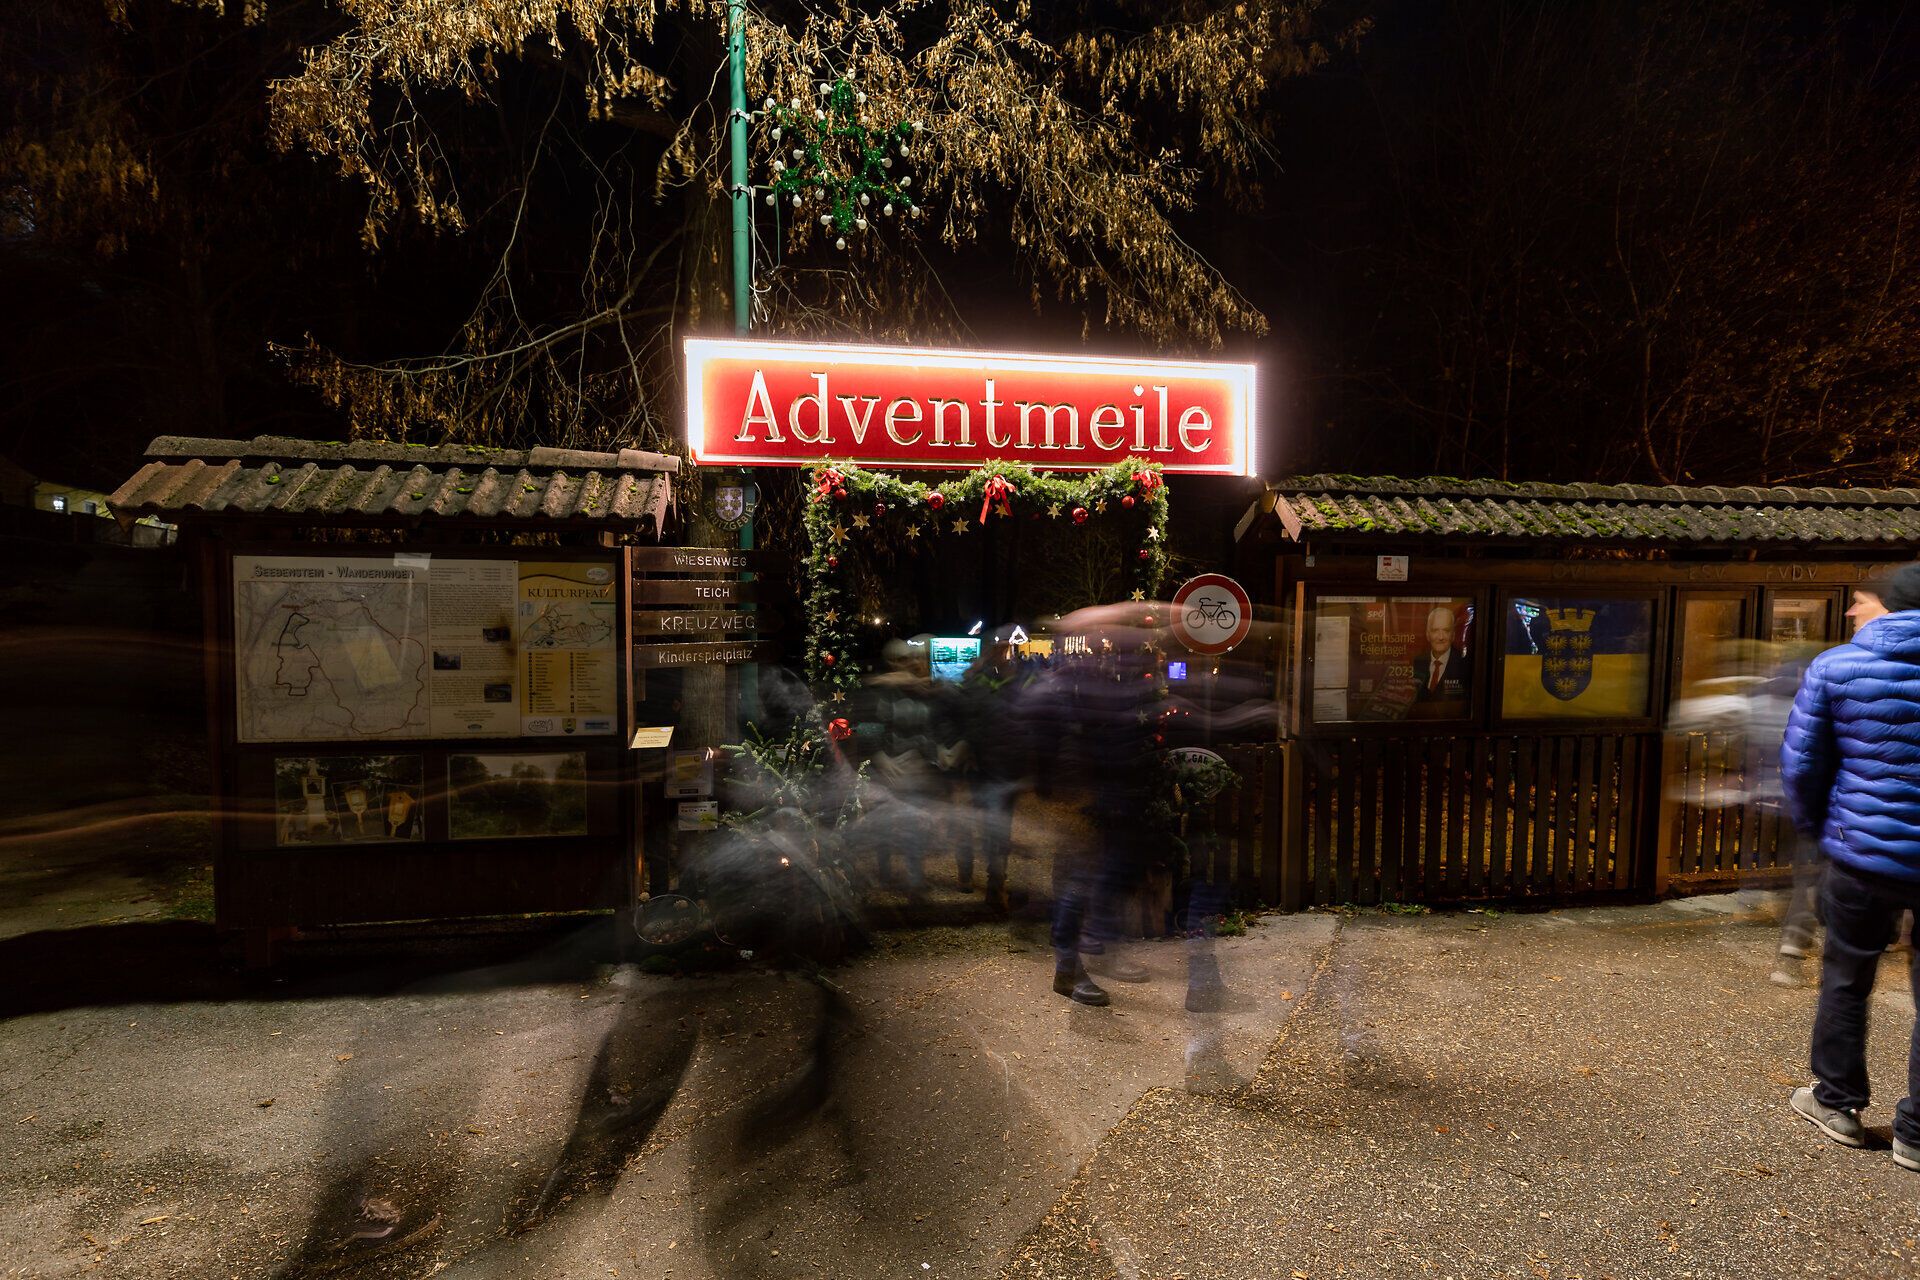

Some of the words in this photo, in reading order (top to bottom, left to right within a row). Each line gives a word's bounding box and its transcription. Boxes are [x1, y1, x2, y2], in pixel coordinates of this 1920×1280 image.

[733, 368, 1213, 453] Adventmeile
[674, 554, 747, 567] WIESENWEG
[255, 565, 324, 578] SEEBENSTEIN
[337, 567, 415, 579] WANDERUNGEN
[528, 588, 608, 599] KULTURPFAD
[696, 587, 730, 598] TEICH
[661, 615, 755, 630] KREUZWEG
[658, 650, 753, 664] Kinderspielplatz
[1388, 666, 1414, 678] 2023
